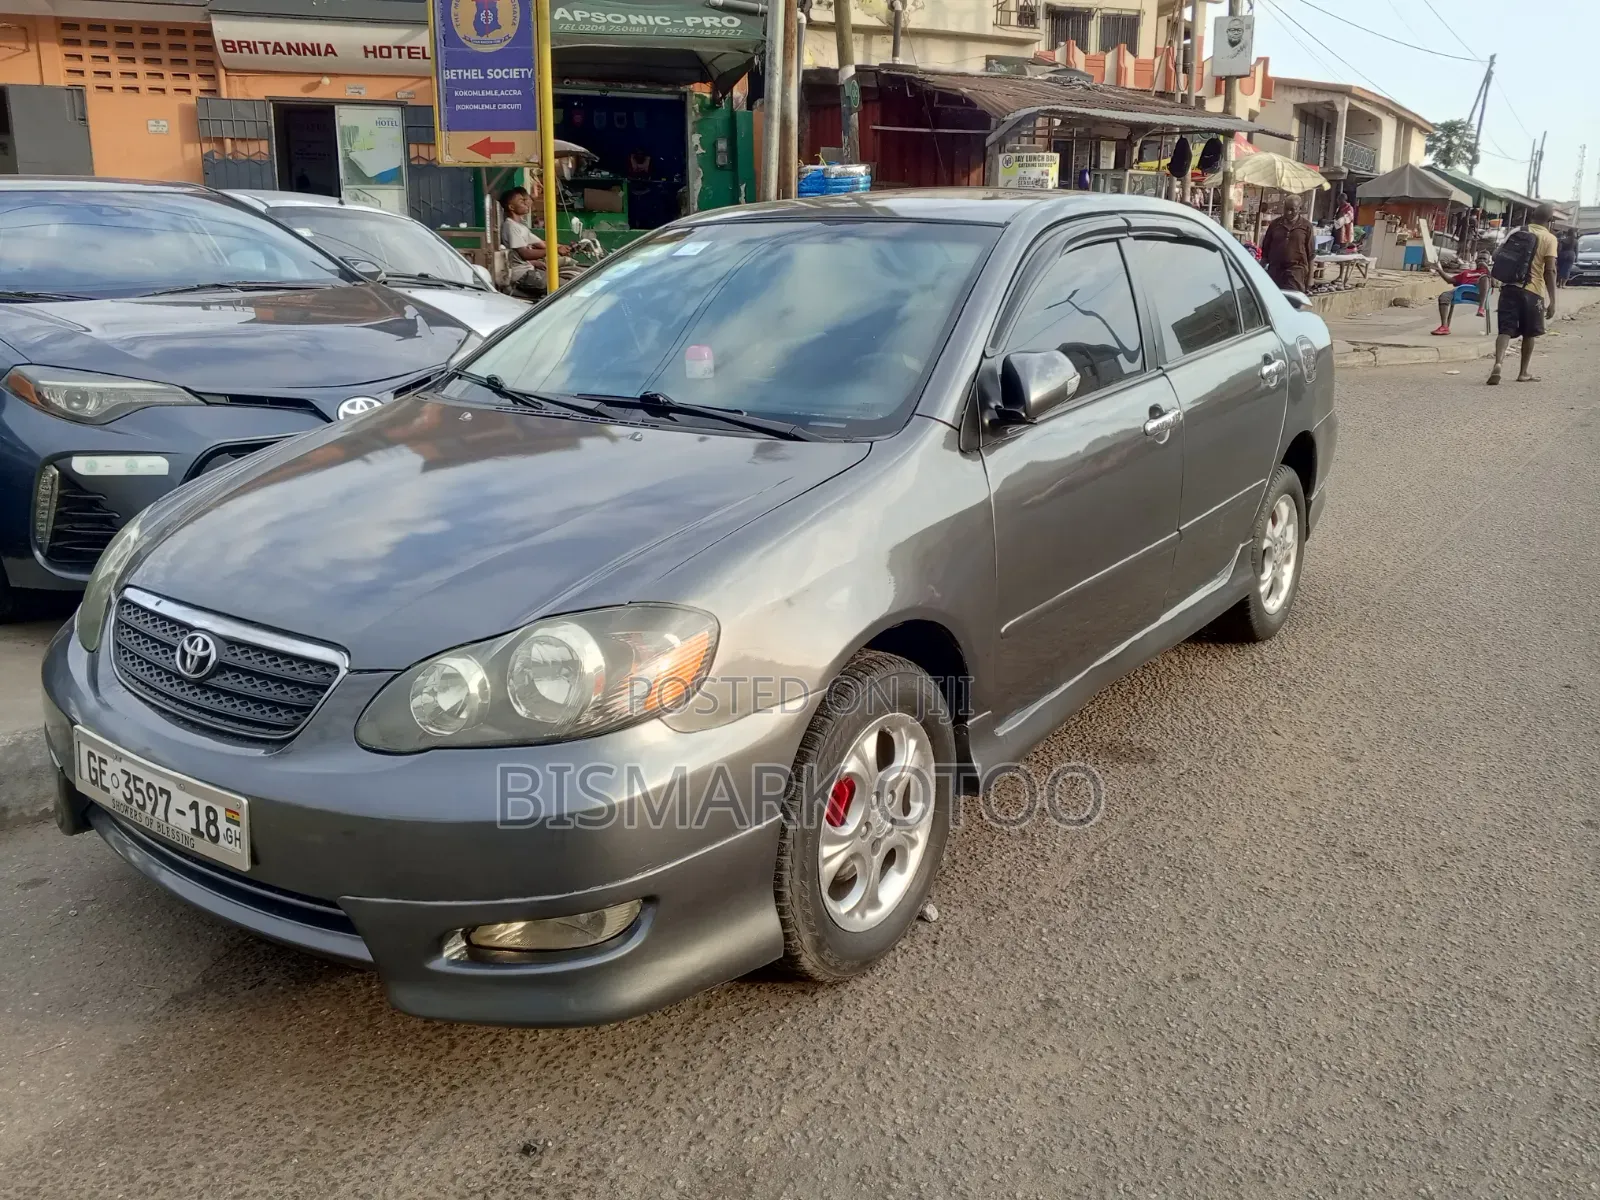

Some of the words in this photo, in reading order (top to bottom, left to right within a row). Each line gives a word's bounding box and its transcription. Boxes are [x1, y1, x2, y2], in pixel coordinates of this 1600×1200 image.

[553, 7, 742, 28] APSONIC-PRO
[221, 39, 338, 58] BRITANNIA
[363, 45, 431, 60] HOTEL
[444, 68, 484, 80] BETHEL
[486, 68, 533, 79] SOCIETY
[375, 119, 399, 127] HOTEL
[1025, 154, 1045, 163] LUNCH
[87, 750, 110, 794] GE
[120, 768, 220, 844] 3597-18
[111, 798, 143, 823] SHOWERS
[144, 816, 154, 828] OF
[156, 823, 195, 849] BLESSING
[226, 827, 242, 850] GH
